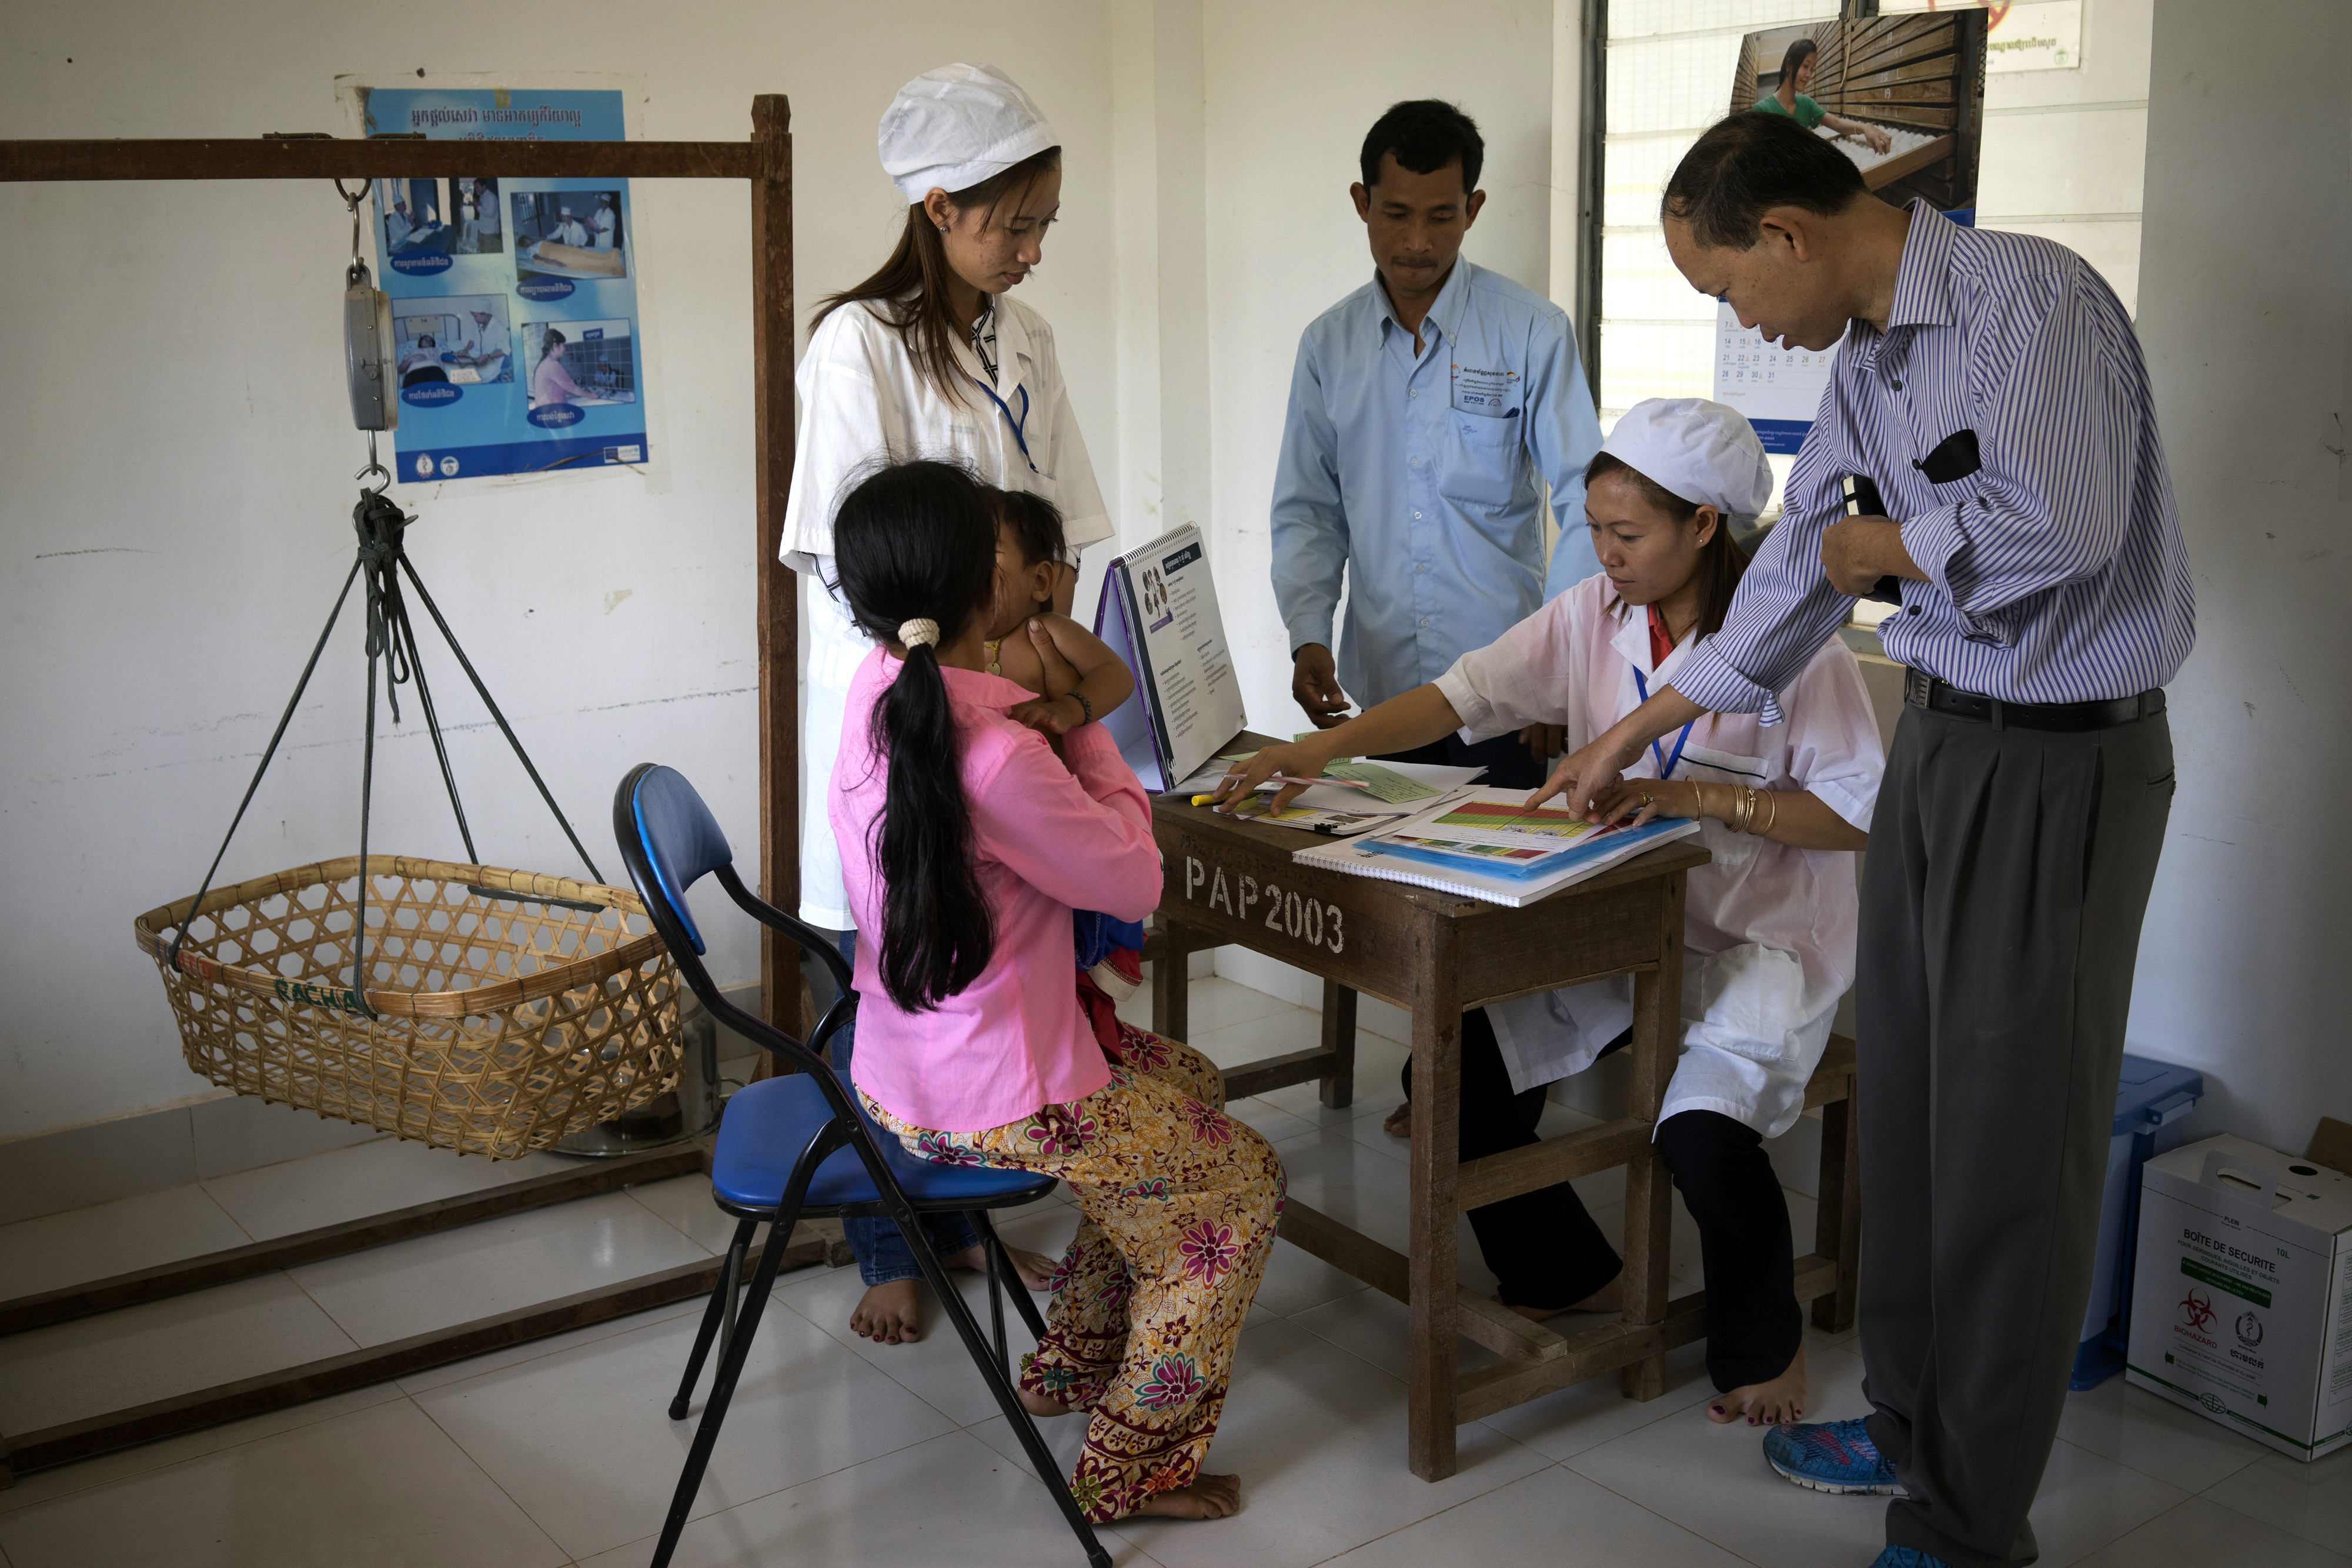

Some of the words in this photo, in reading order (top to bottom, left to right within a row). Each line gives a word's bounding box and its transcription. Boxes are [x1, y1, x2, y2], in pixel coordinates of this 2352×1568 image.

[1186, 855, 1259, 920] PAP
[1264, 884, 1345, 954] 2003
[156, 940, 213, 981] UAID
[275, 979, 361, 1013] RACHA
[2224, 1216, 2240, 1226] PLEIN
[2177, 1239, 2191, 1249] POUR
[2193, 1244, 2223, 1262] SERINGUES,
[2224, 1258, 2250, 1272] AIGUILLES
[2259, 1272, 2280, 1284] OBJETS
[2184, 1229, 2211, 1247] BOÎTE
[2213, 1241, 2226, 1253] DE
[2228, 1247, 2276, 1273] SECURITE
[2276, 1248, 2290, 1259] 10L
[2201, 1256, 2229, 1271] COUPANTS
[2174, 1325, 2217, 1349] BIOHAZARD
[2179, 1343, 2199, 1355] Conserver
[2230, 1348, 2264, 1369] ហាមលក់
